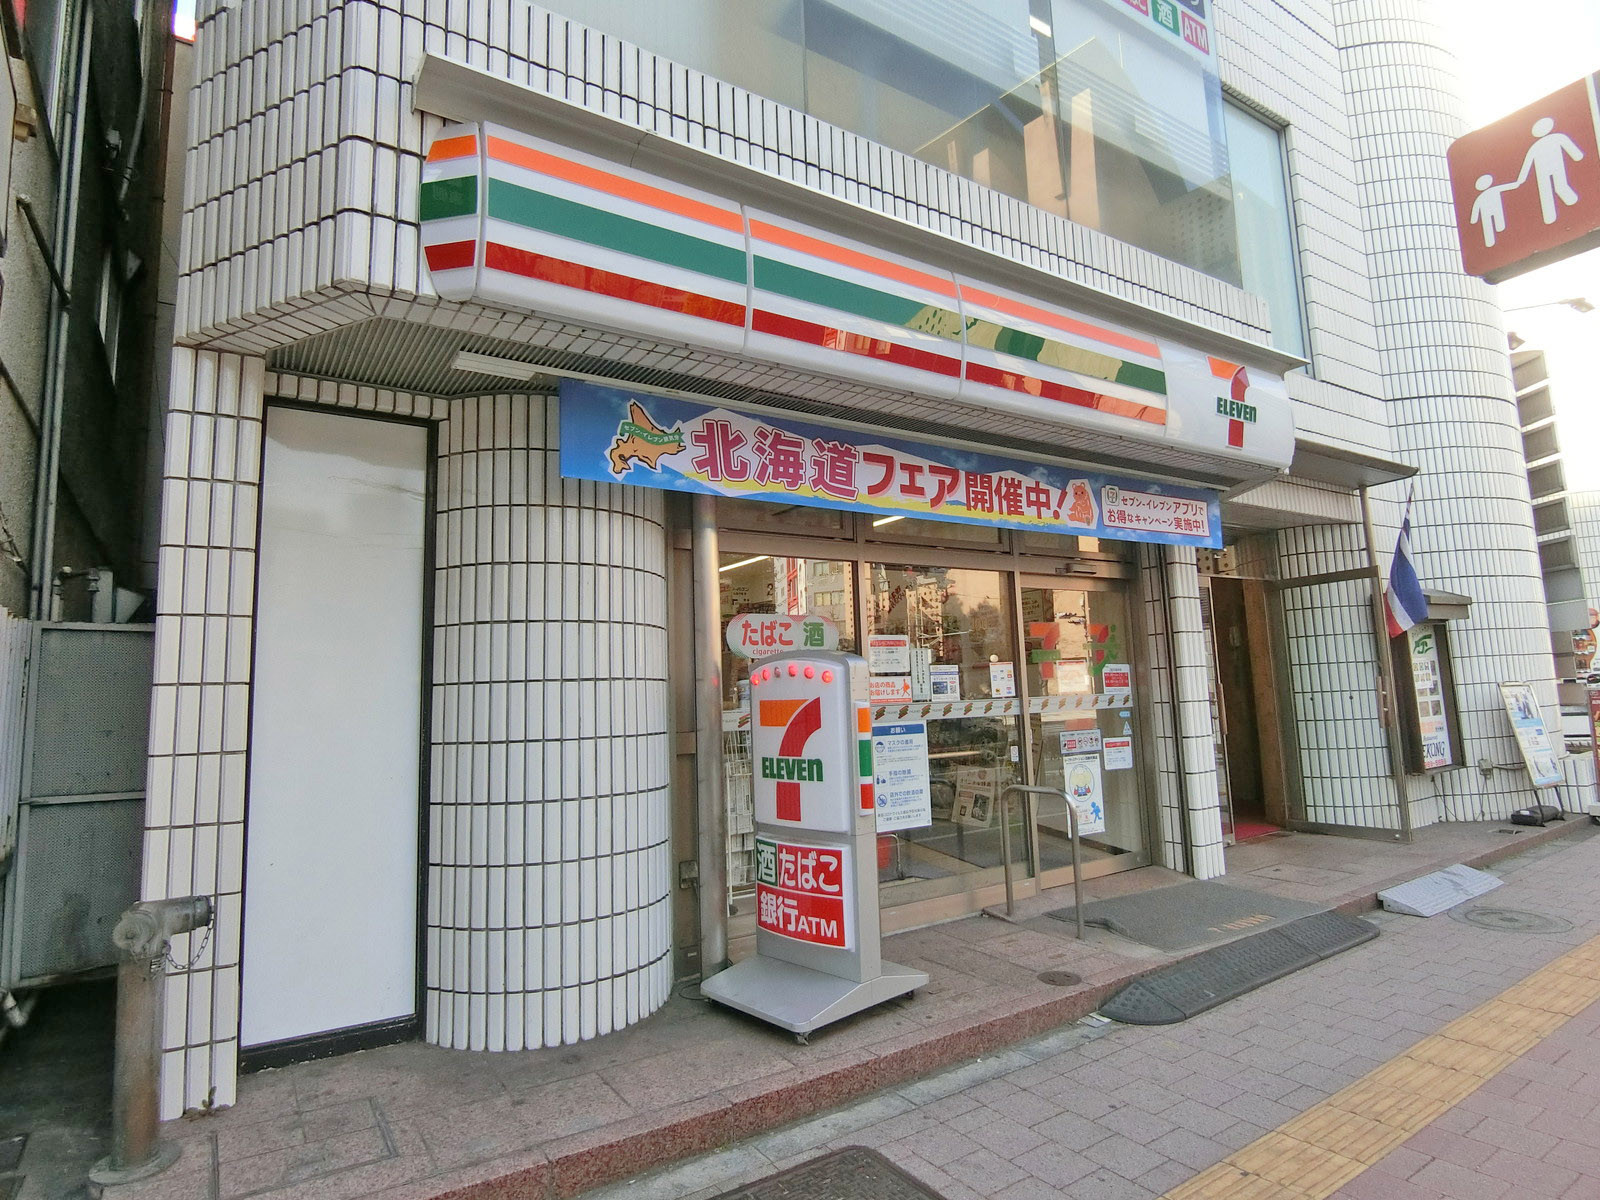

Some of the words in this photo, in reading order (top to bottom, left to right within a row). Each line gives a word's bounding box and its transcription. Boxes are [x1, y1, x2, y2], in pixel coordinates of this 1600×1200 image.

[1157, 0, 1173, 29] 酒
[1184, 17, 1208, 51] ATM
[742, 620, 794, 647] たばこ
[803, 622, 825, 647] 酒
[756, 844, 776, 882] 酒
[778, 848, 840, 893] たばこ
